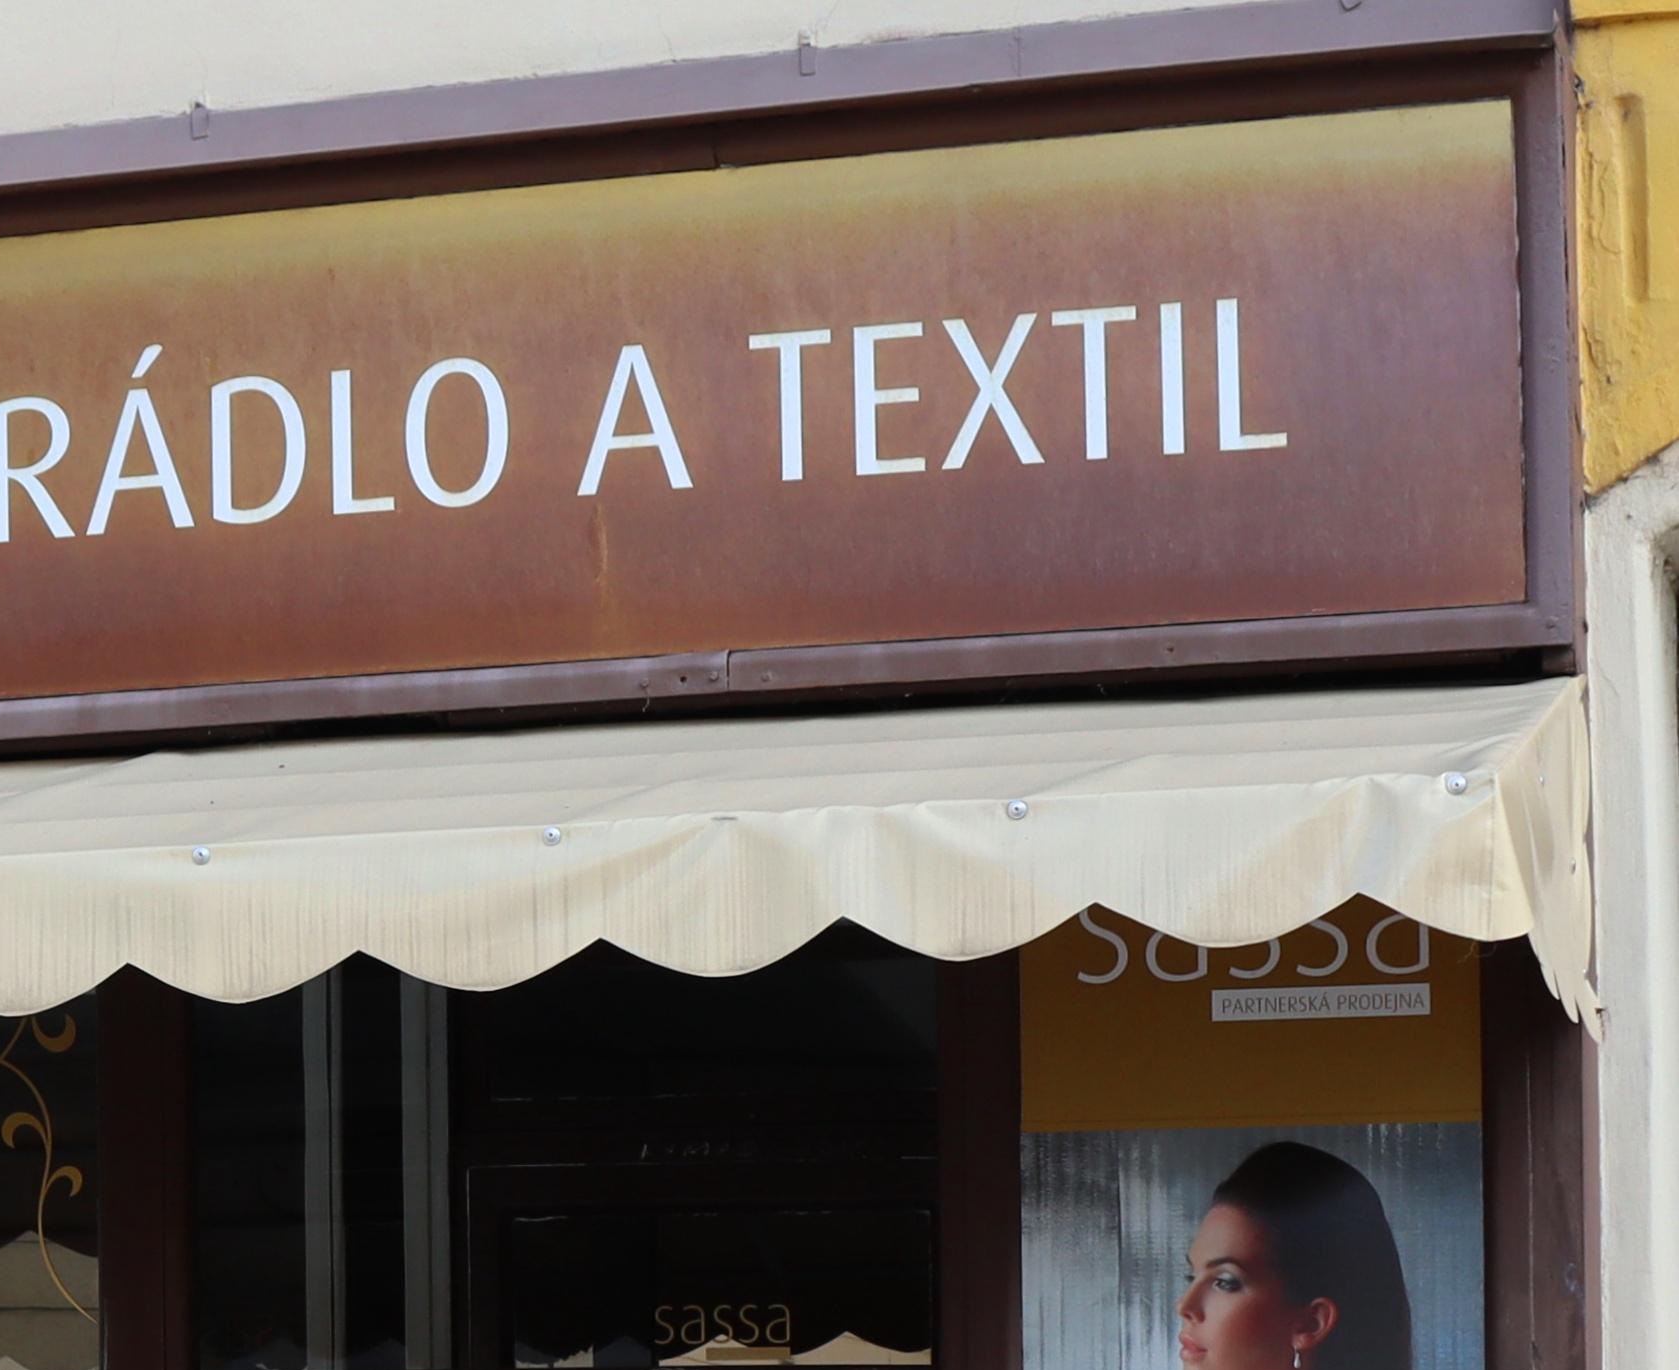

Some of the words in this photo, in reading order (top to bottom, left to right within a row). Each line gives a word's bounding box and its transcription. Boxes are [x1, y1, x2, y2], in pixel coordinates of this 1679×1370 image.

[577, 345, 694, 496] A
[748, 298, 1288, 481] TEXTIL
[1222, 992, 1331, 1014] PARTNERSKÁ
[1337, 991, 1425, 1013] PRODEJNA
[654, 1303, 791, 1345] sassa
